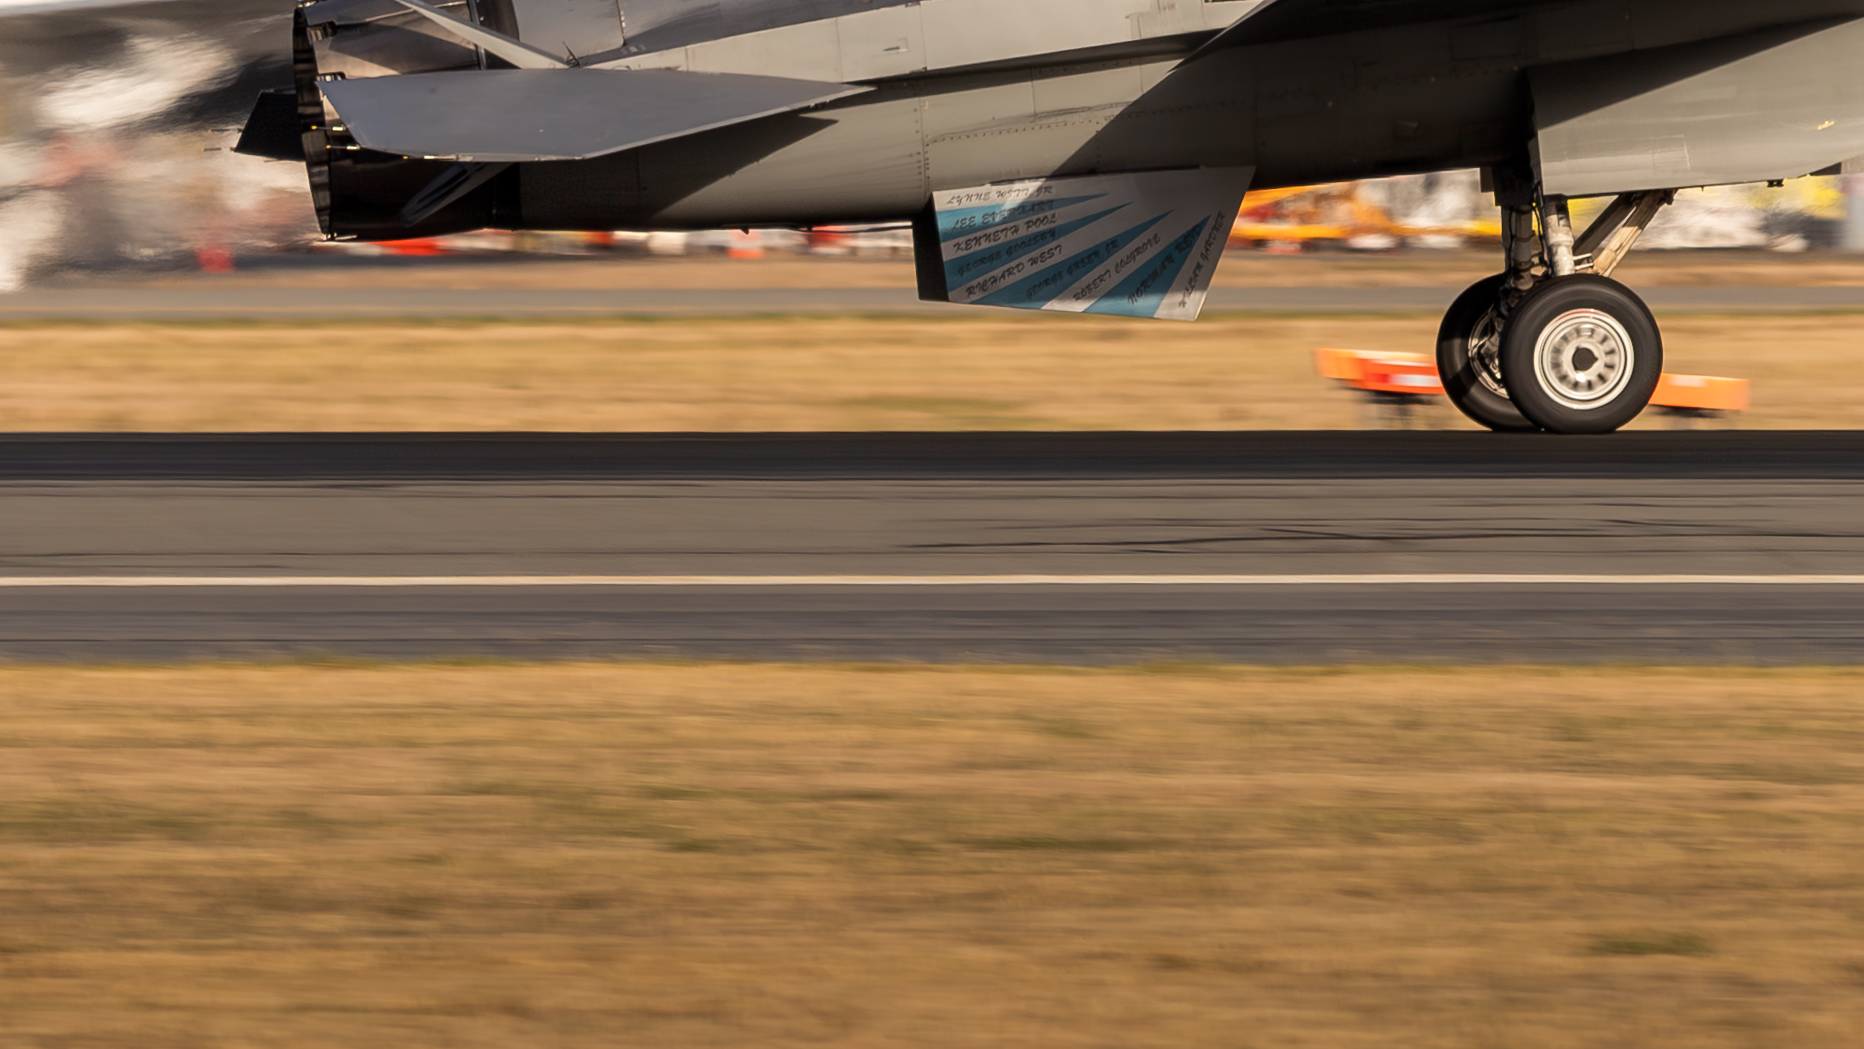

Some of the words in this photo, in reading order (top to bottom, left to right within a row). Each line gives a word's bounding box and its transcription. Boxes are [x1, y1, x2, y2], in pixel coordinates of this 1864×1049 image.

[946, 191, 992, 207] LYNNE
[951, 215, 977, 231] LEE
[953, 224, 1020, 253] KENNETH
[1024, 212, 1057, 231] POOL
[964, 262, 1024, 298] RICHARD
[1026, 244, 1062, 267] WEST
[1072, 268, 1111, 302] ROBERT
